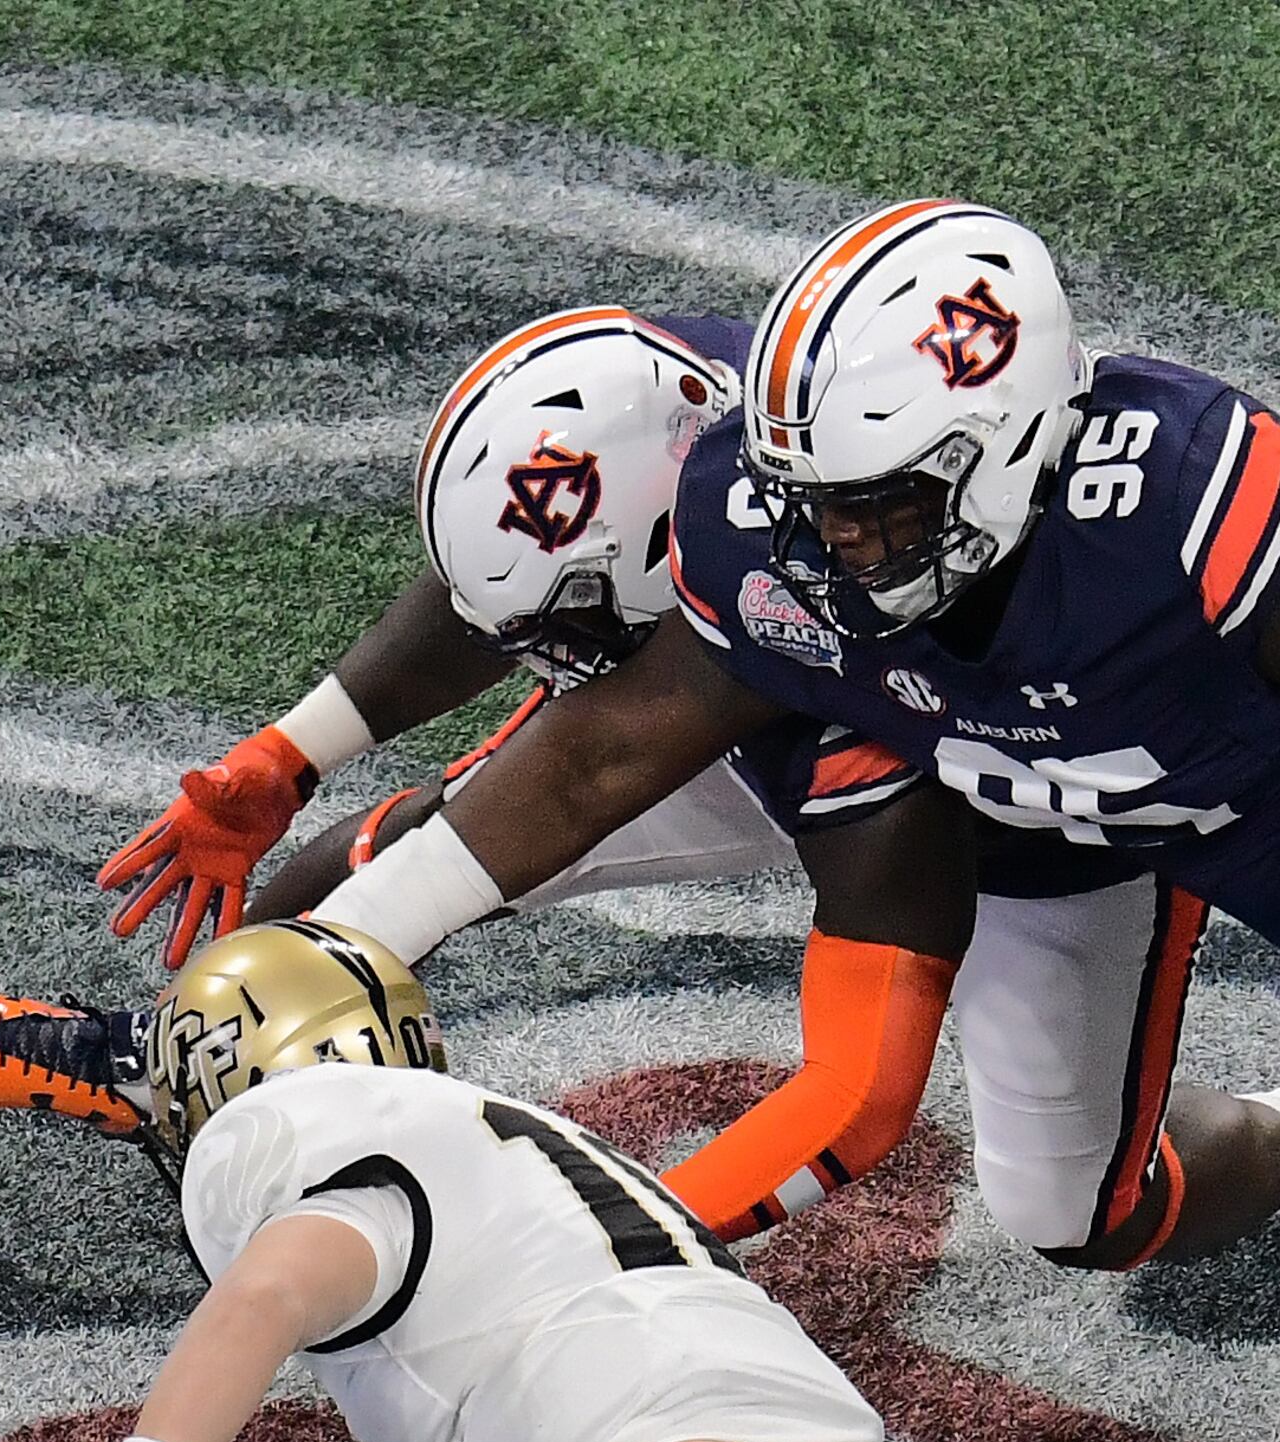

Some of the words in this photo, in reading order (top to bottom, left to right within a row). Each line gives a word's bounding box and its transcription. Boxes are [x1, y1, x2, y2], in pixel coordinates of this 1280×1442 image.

[1067, 410, 1161, 520] 95
[746, 618, 839, 654] PEACH
[955, 717, 1062, 743] AUBURN
[143, 995, 242, 1118] UCF
